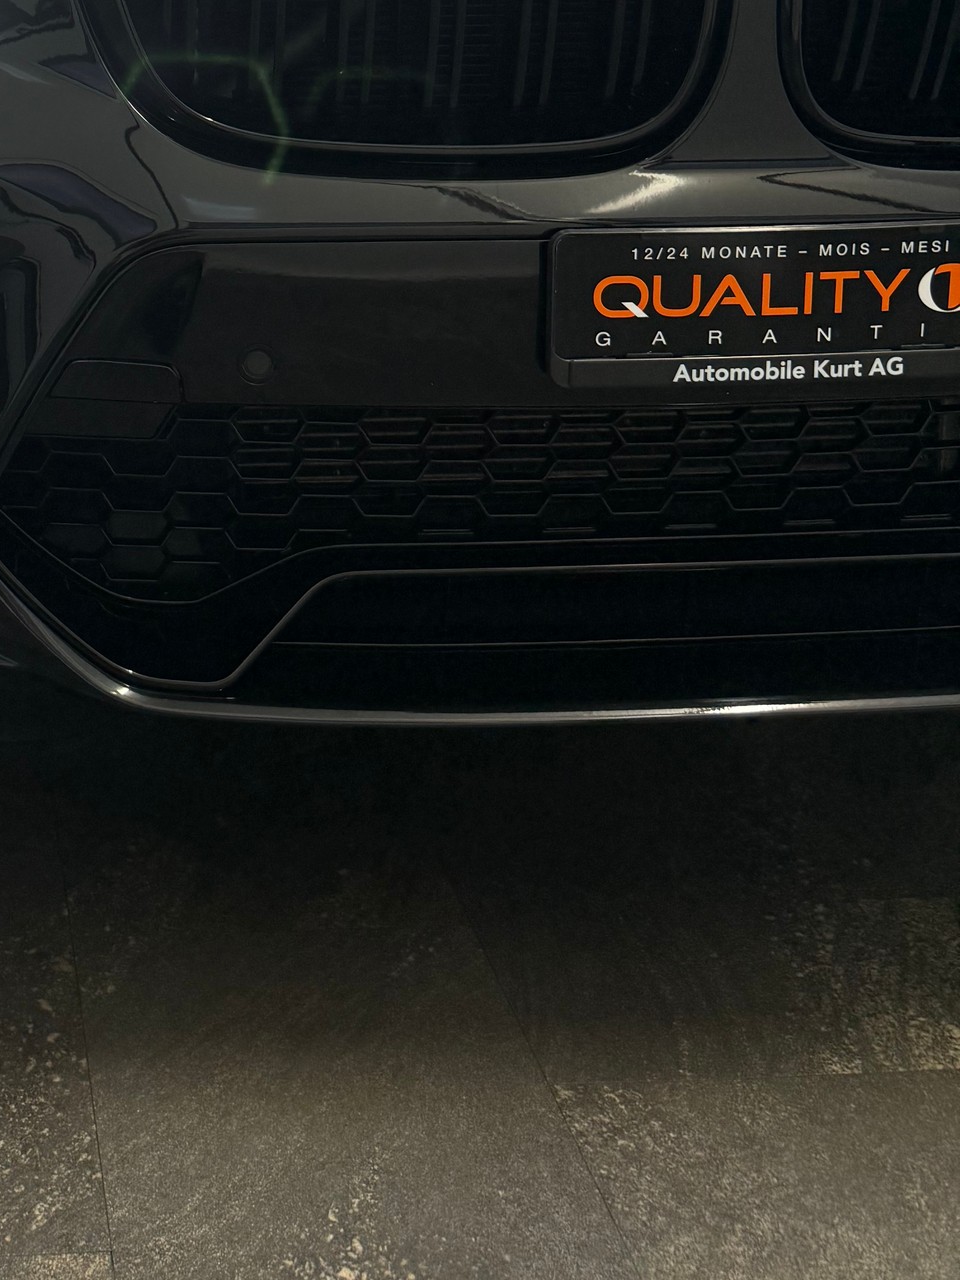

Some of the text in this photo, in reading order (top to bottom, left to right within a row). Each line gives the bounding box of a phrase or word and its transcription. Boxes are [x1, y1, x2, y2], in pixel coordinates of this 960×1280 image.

[631, 247, 689, 260] 12/24
[701, 245, 788, 259] MONATE
[819, 242, 871, 257] MOIS
[901, 240, 950, 254] MESI
[673, 356, 904, 383] Automobile Kurt AG
